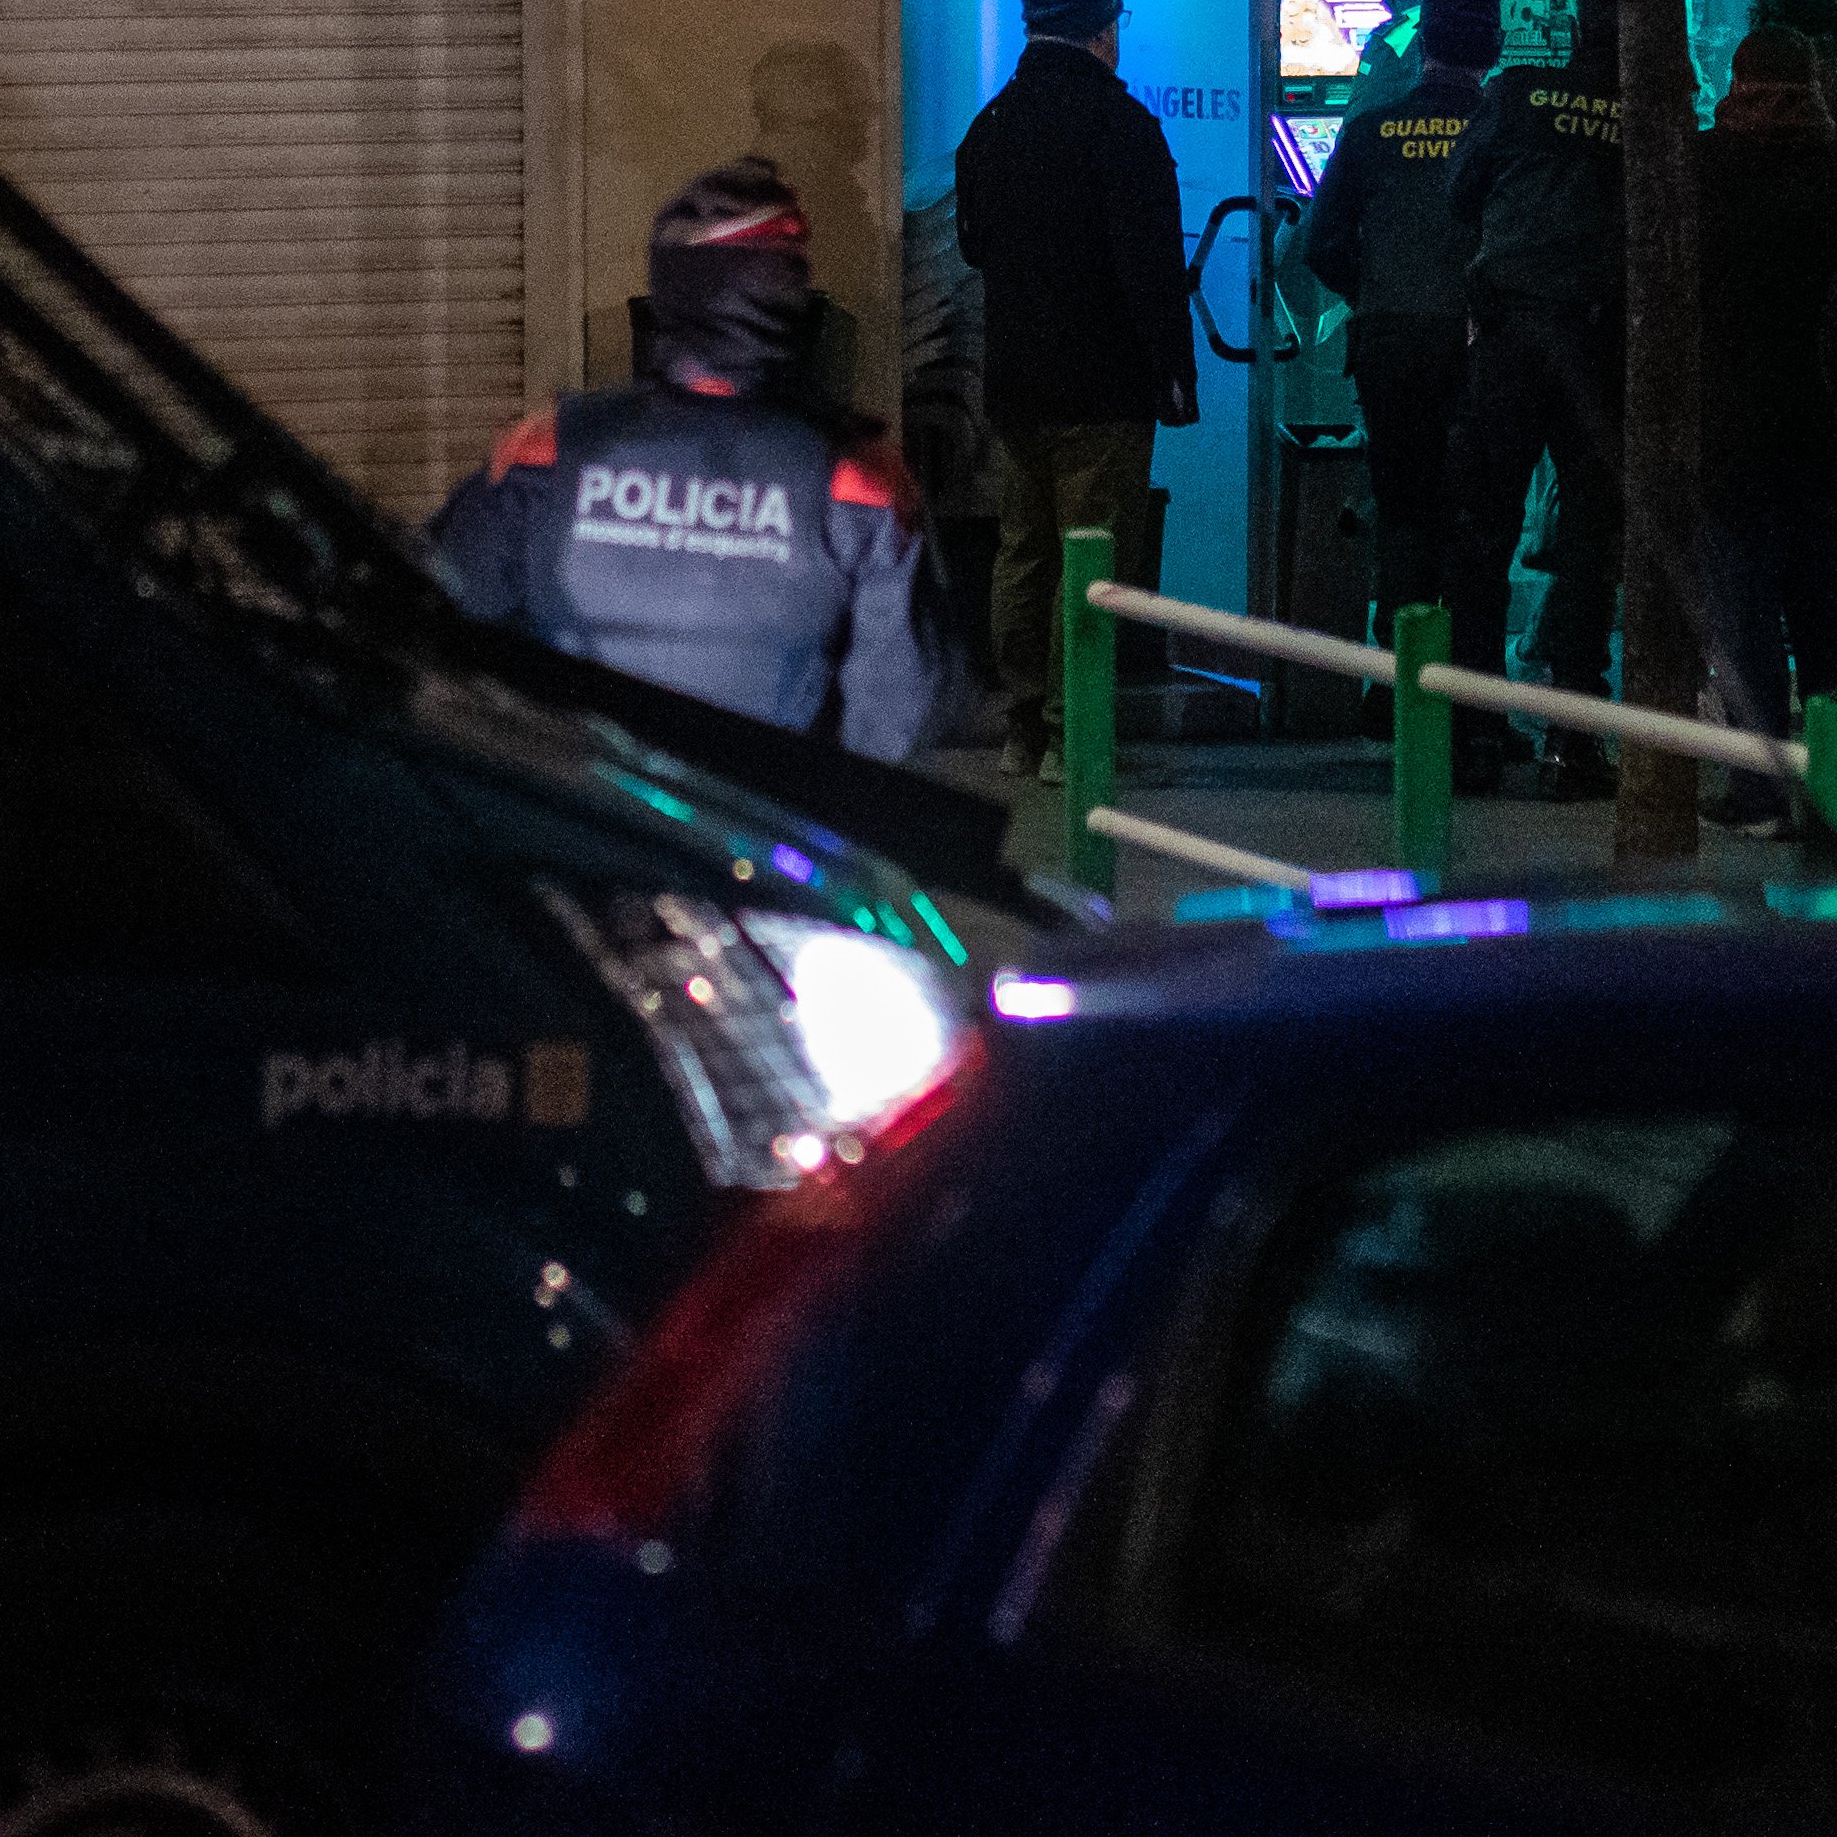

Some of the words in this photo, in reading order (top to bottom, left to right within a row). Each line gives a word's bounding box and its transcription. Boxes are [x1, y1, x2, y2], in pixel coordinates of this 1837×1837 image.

[1135, 85, 1241, 122] NGELES
[576, 464, 793, 538] POLICIA
[261, 1038, 510, 1131] policia
